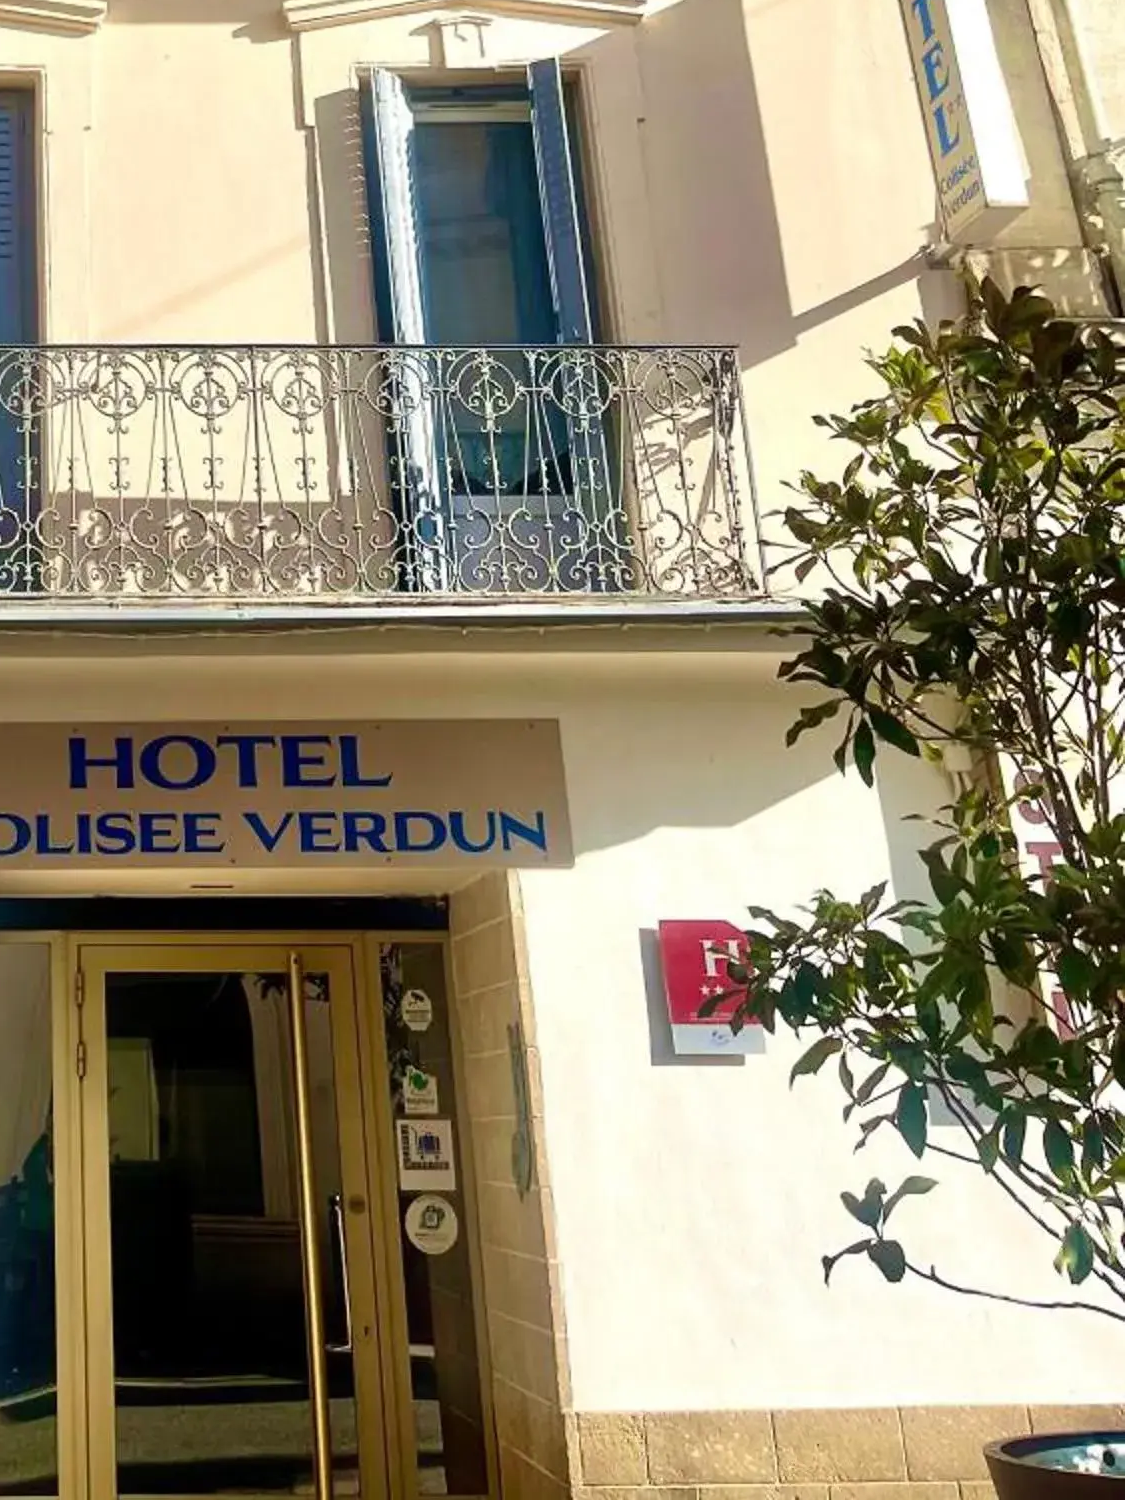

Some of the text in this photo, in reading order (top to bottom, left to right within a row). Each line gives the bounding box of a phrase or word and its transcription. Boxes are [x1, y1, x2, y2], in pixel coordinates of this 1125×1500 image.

[68, 735, 392, 790] HOTEL
[242, 810, 548, 854] VERDUN
[699, 939, 742, 977] H
